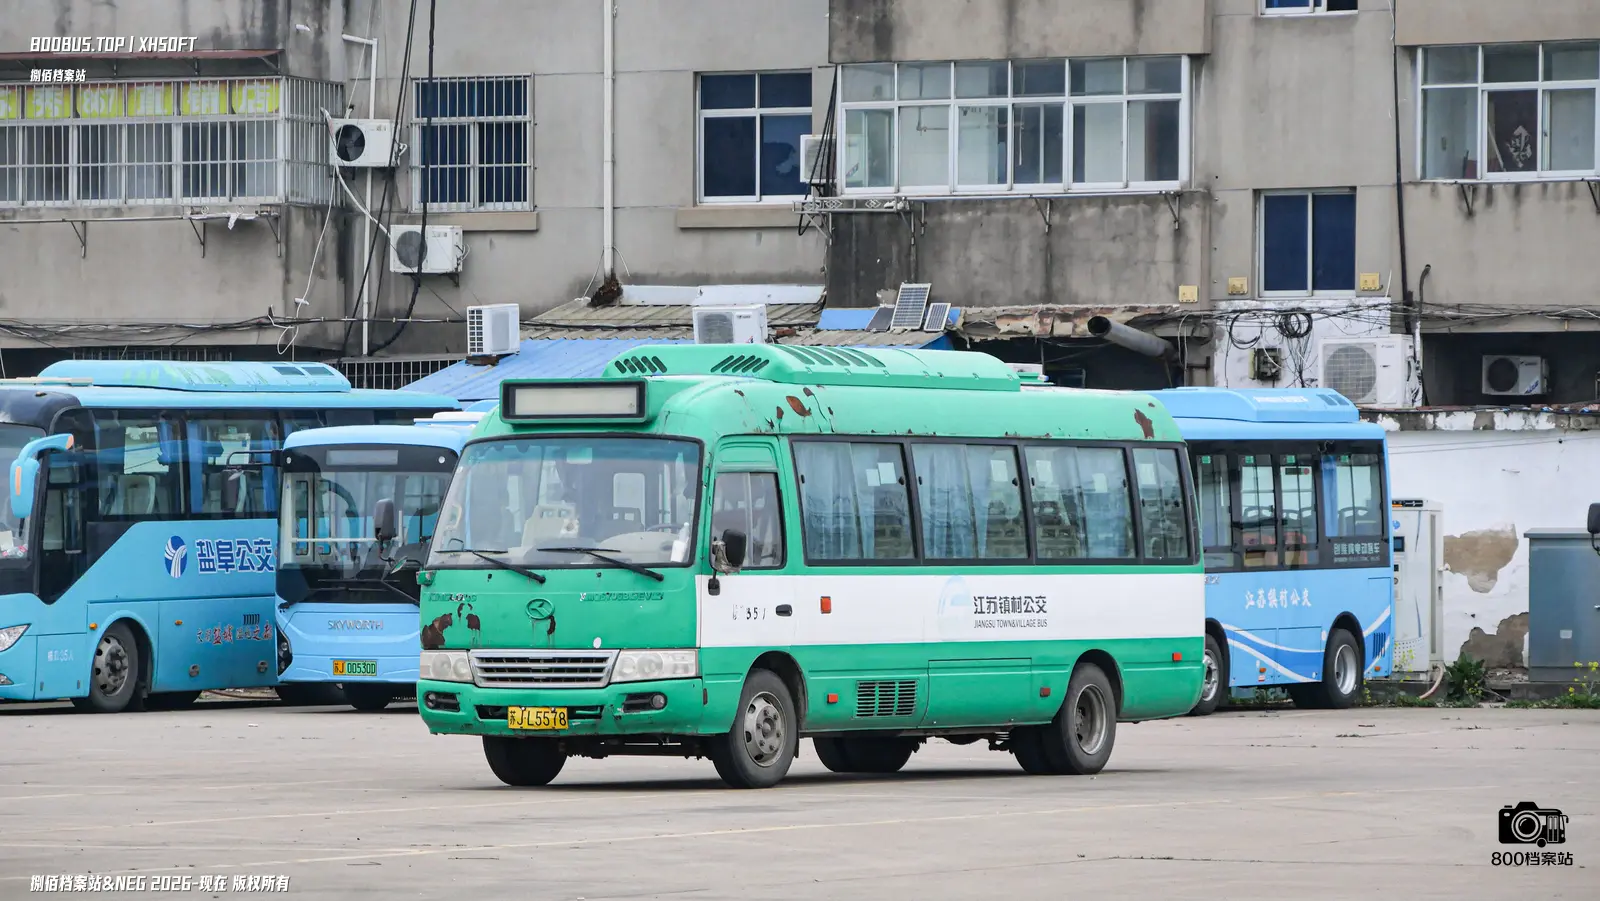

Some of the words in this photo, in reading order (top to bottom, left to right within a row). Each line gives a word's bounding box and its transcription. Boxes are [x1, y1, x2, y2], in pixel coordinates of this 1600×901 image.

[195, 537, 275, 574] 盐阜公交
[973, 595, 1048, 614] 江苏镇村公交
[328, 619, 384, 631] SKYWORTH
[974, 619, 996, 628] JIANGSU
[997, 619, 1036, 628] TOWN&VILLAGE
[1037, 618, 1048, 628] BUS
